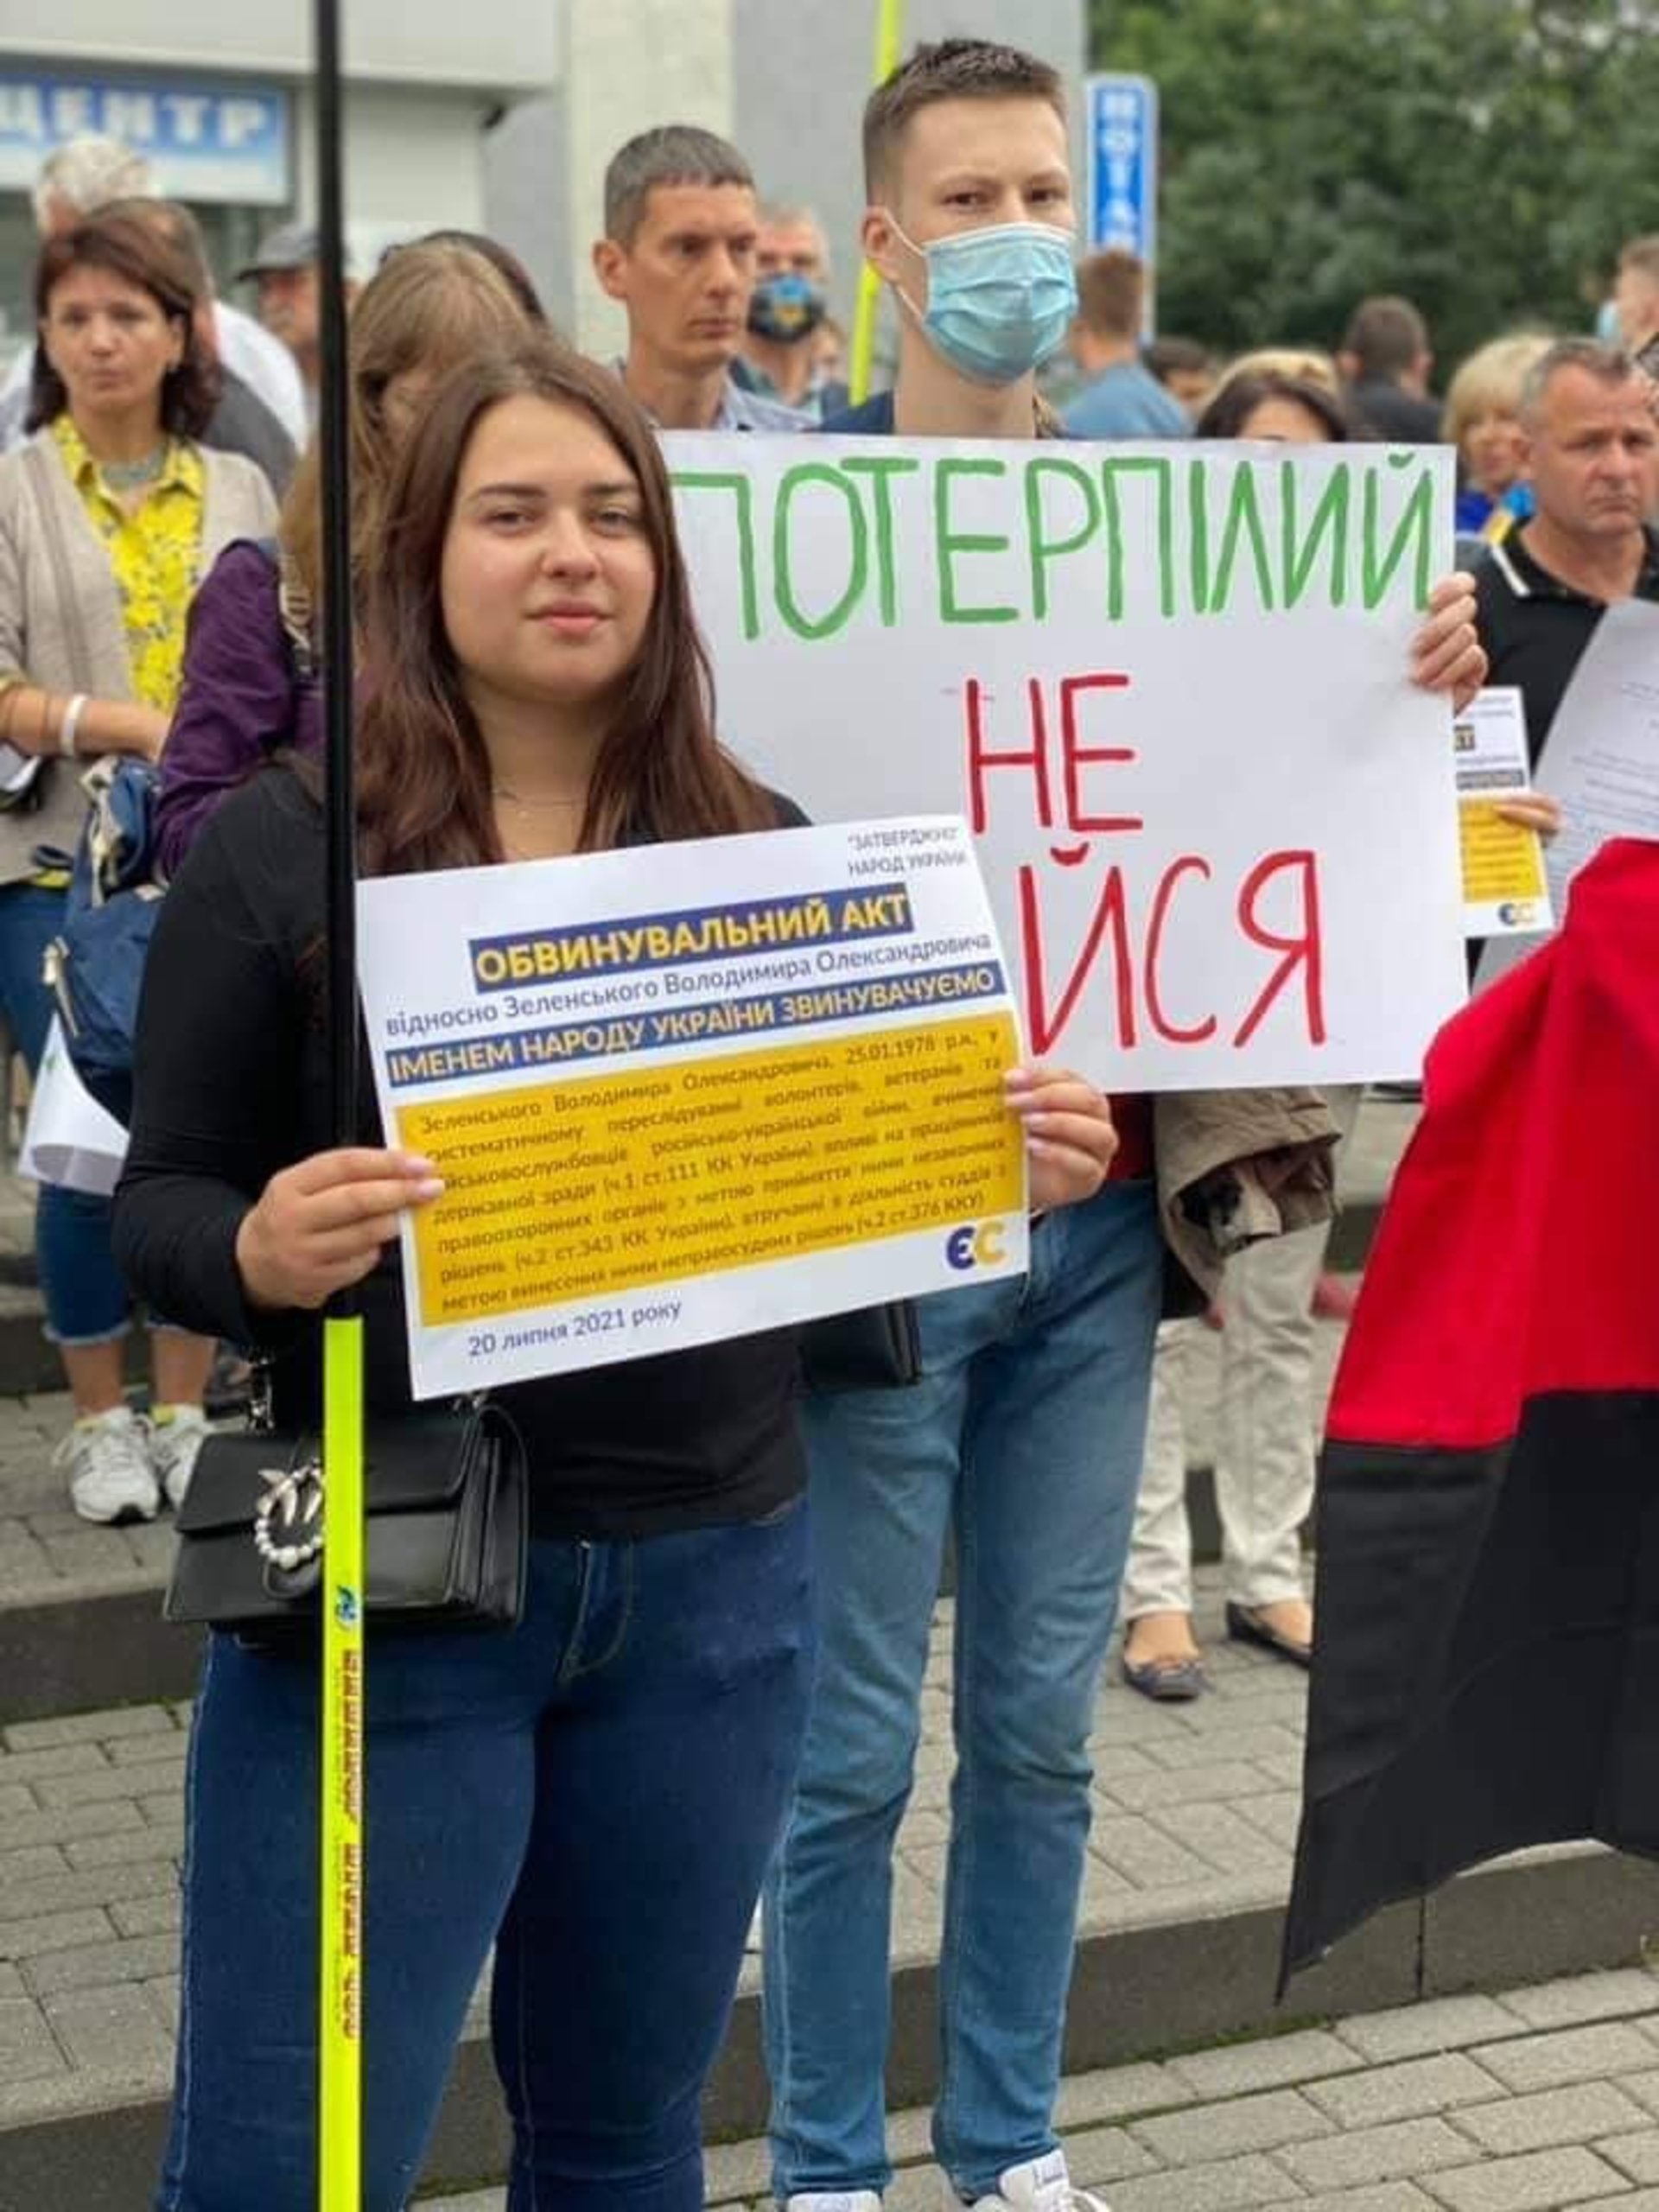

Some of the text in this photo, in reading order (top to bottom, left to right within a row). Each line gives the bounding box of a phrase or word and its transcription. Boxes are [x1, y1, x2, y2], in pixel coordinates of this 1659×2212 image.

[666, 452, 1433, 640] ПОТЕРПІЛИЙ
[964, 673, 1143, 834] НЕ
[847, 855, 904, 876] НАРОД
[475, 893, 908, 982] ОБВИНУВАЛЬНИЙ АКТ
[385, 929, 991, 1038] відносно Зеленського Володимира Олександровича
[390, 968, 995, 1081] ІМЕНЕМ НАРОДУ УКРАЇНИ ЗВИНУВАЧУЄМО
[418, 1097, 541, 1134] Зеленського
[552, 1077, 671, 1113] Володимира
[943, 1217, 1009, 1273] ЄС
[467, 1299, 683, 1358] 20 липня 2021 року
